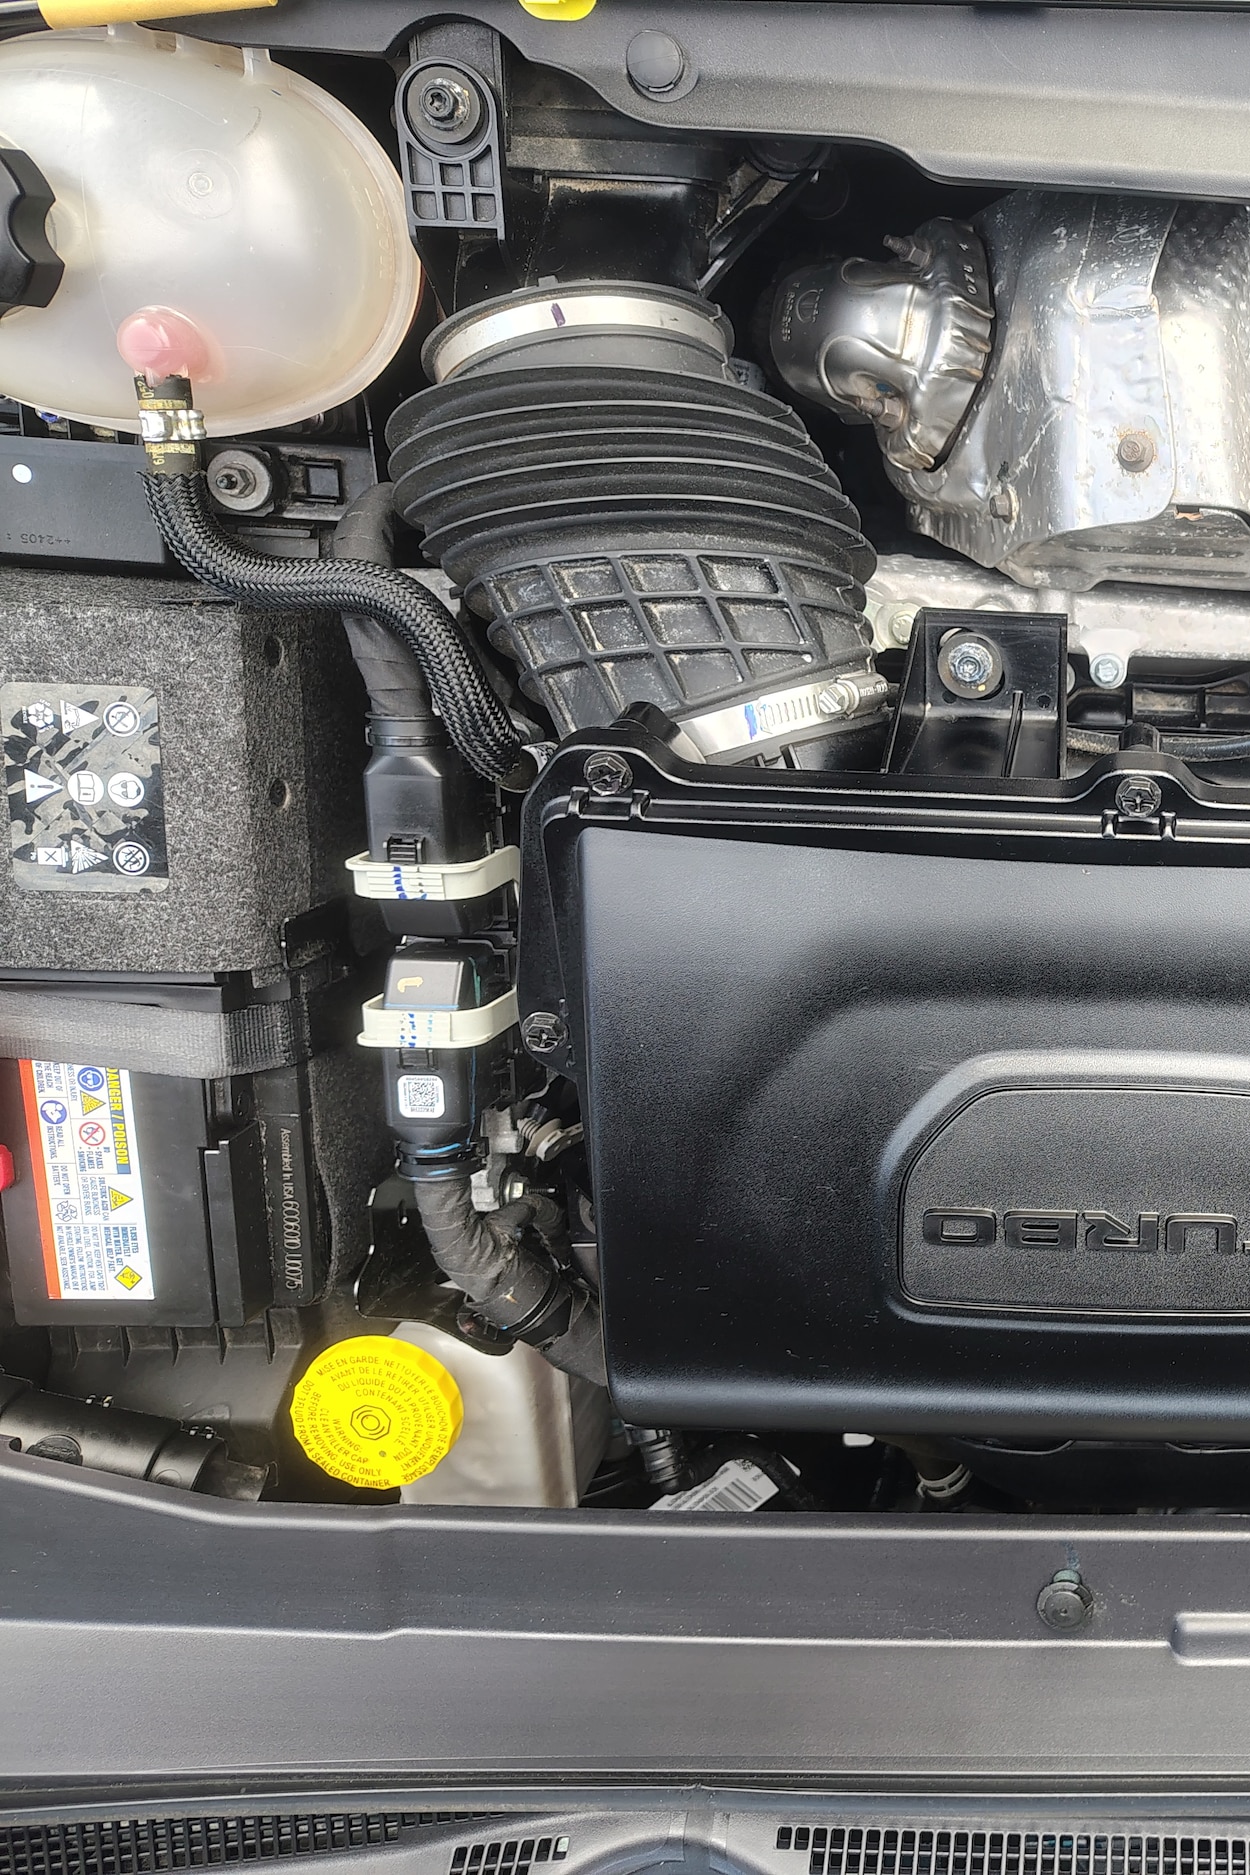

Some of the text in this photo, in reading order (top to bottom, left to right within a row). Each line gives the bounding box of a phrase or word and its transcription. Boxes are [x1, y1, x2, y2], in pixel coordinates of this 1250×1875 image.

[44, 1063, 54, 1088] THE REACH
[106, 1068, 123, 1111] DANGER
[55, 1126, 63, 1138] READ
[113, 1123, 129, 1164] POISON
[281, 1128, 291, 1171] Assembled
[77, 1151, 86, 1172] SMOKING
[86, 1151, 95, 1169] FLAMES
[95, 1151, 104, 1169] SPARKS
[81, 1184, 90, 1200] SEVERE
[90, 1177, 100, 1216] CAUSE BLINDNESS
[99, 1177, 108, 1199] SULFURIC
[283, 1183, 294, 1199] USA
[104, 1227, 112, 1247] MEDICAL
[121, 1227, 131, 1257] IMMEDIATELY
[66, 1231, 74, 1246] VEHICLE
[70, 1265, 78, 1280] MANUAL
[76, 1247, 84, 1262] FOLLOW
[95, 1259, 103, 1269] VENT
[106, 1248, 114, 1259] HELP
[78, 1264, 88, 1291] INSTRUCTIONS
[96, 1270, 104, 1279] CAPS
[316, 1363, 333, 1376] MISE
[335, 1358, 348, 1367] EN
[373, 1367, 383, 1376] LE
[384, 1359, 425, 1386] NETTOYER
[330, 1367, 356, 1383] AVANT
[386, 1372, 420, 1395] RETIRER
[302, 1380, 314, 1396] DOT
[422, 1383, 435, 1395] LE
[355, 1388, 407, 1414] CONTENANT
[295, 1403, 304, 1423] FLUID
[337, 1382, 350, 1391] DU
[351, 1377, 385, 1388] LIQUIDE
[388, 1383, 405, 1397] DOT
[408, 1402, 424, 1448] PROVENANT
[430, 1394, 449, 1430] BOUCHON
[298, 1425, 311, 1447] FROM
[308, 1392, 382, 1477] BEFORE REMOVING. USE ONLY
[320, 1408, 369, 1464] CLEAN FILLER CAP
[332, 1418, 363, 1453] WARNING:
[437, 1432, 448, 1445] DE
[400, 1431, 435, 1471] UNIQUEMENT
[312, 1453, 340, 1477] SEALED
[341, 1473, 394, 1486] CONTAINER.
